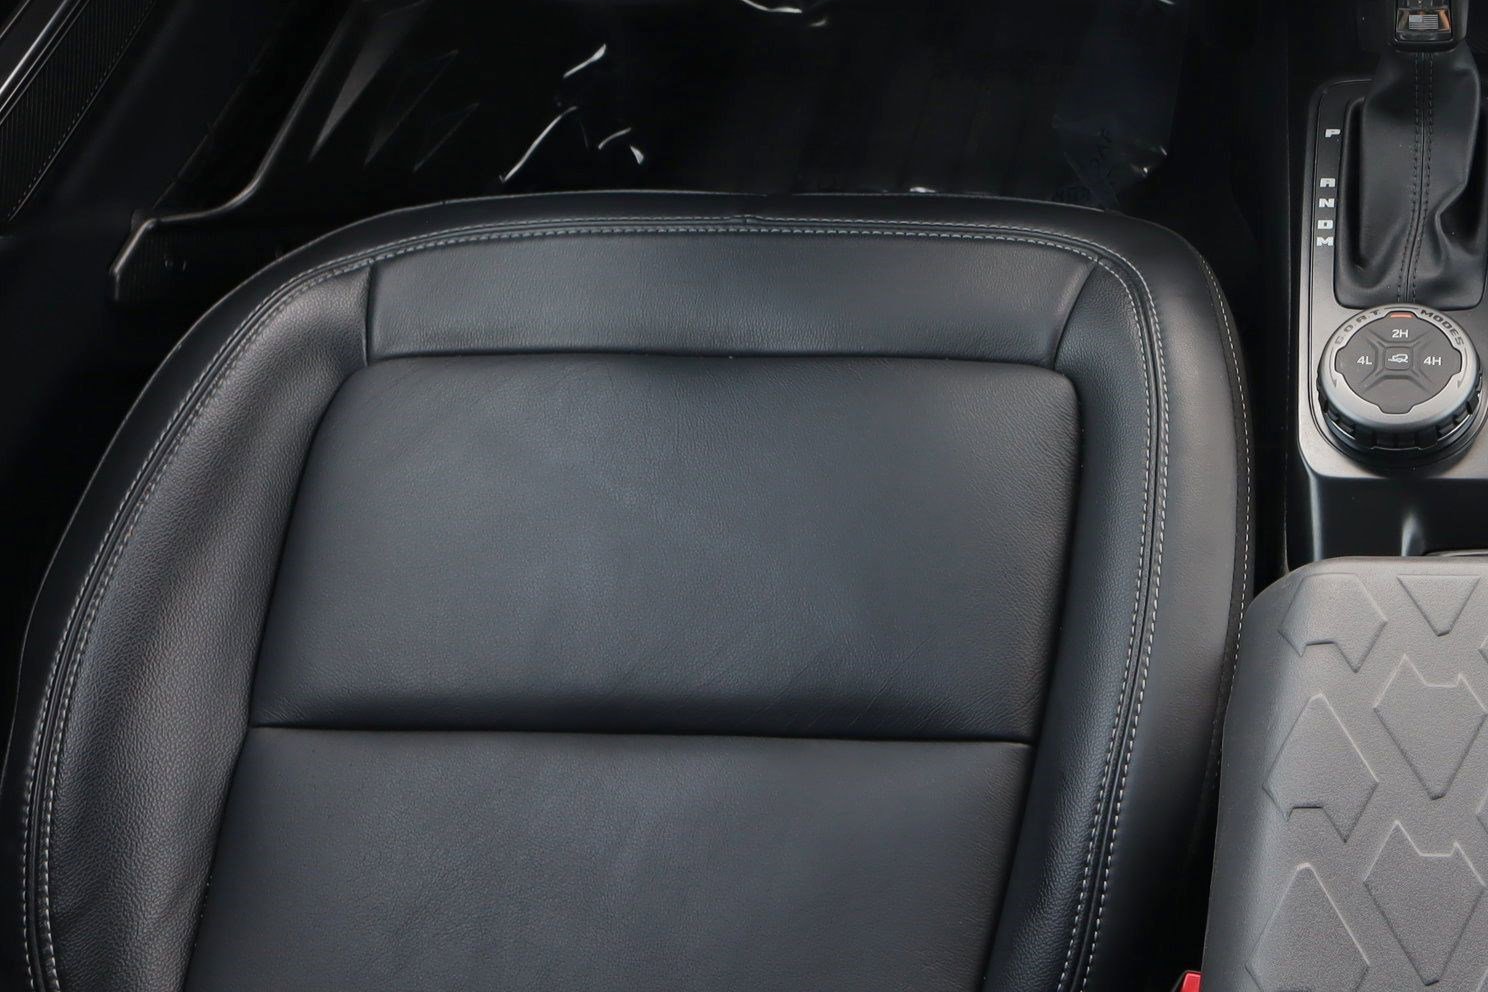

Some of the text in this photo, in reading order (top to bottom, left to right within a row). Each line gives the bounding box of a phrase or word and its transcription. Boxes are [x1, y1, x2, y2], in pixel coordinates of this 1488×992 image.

[1325, 129, 1341, 138] P
[1319, 198, 1335, 208] N
[1317, 220, 1333, 229] D
[1316, 236, 1334, 246] M
[1420, 310, 1465, 346] MODES
[1391, 329, 1409, 338] 2H
[1356, 356, 1372, 365] 4L
[1423, 356, 1442, 366] 4H
